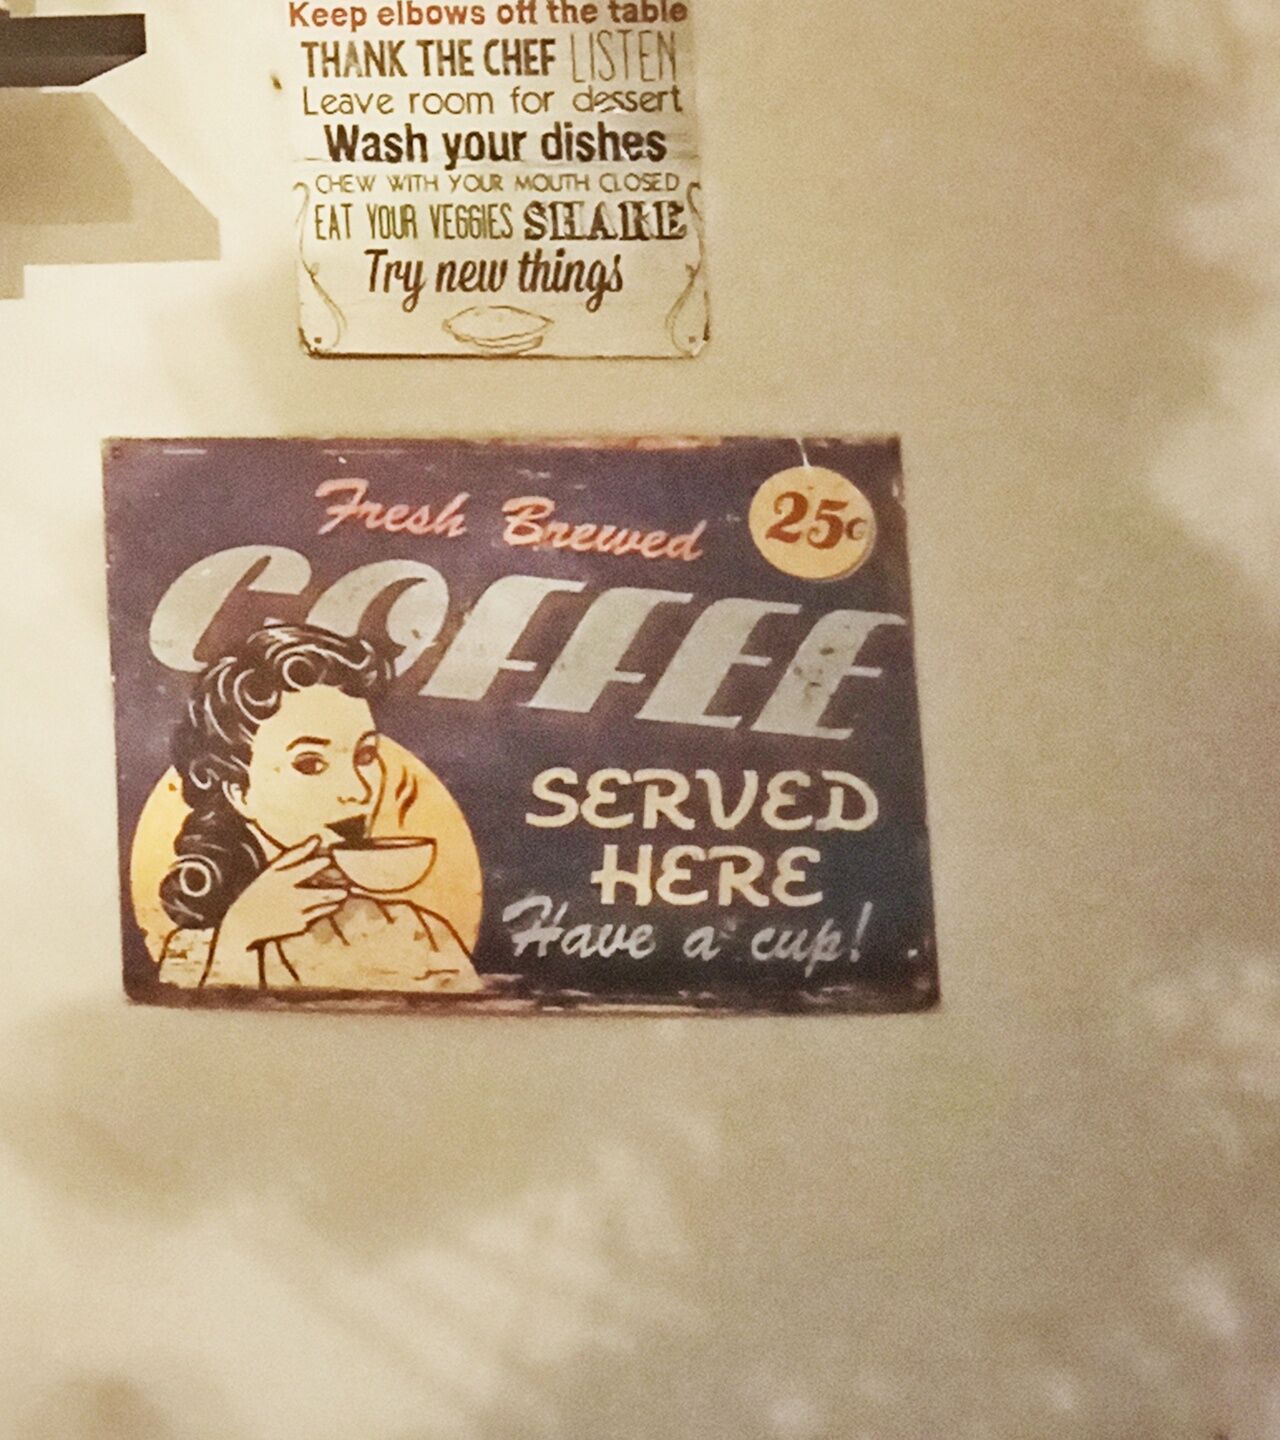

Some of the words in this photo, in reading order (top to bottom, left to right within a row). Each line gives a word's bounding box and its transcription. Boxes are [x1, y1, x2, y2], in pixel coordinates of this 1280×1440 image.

[288, 0, 368, 31] Keep
[377, 0, 486, 27] elbows
[496, 0, 537, 26] off
[300, 40, 408, 78] THANK
[416, 39, 475, 78] THE
[483, 38, 556, 77] CHEF
[570, 30, 678, 83] LISTEN
[302, 86, 394, 116] Leave
[408, 89, 494, 115] room
[510, 86, 555, 113] for
[572, 84, 683, 114] dessert
[324, 123, 428, 162] Wash
[442, 129, 527, 171] your
[540, 121, 667, 163] dishes
[315, 174, 376, 194] CHEW
[388, 174, 439, 193] WITH
[448, 173, 504, 193] YOUR
[514, 172, 590, 193] MOUTH
[598, 172, 680, 192] CLOSED
[314, 203, 353, 240] EAT
[367, 203, 418, 240] YOUR
[428, 203, 514, 240] VEGGIES
[523, 199, 687, 241] SHARE
[363, 249, 426, 313] Try
[435, 259, 509, 292] new
[517, 248, 623, 313] things
[315, 477, 471, 538] Fresh
[502, 495, 708, 561] Brewed
[148, 544, 907, 741] COFFEE
[525, 766, 880, 831] SERVED
[590, 843, 824, 907] HERE
[502, 895, 656, 959] Have
[682, 925, 720, 960] a
[750, 901, 874, 978] cup!
